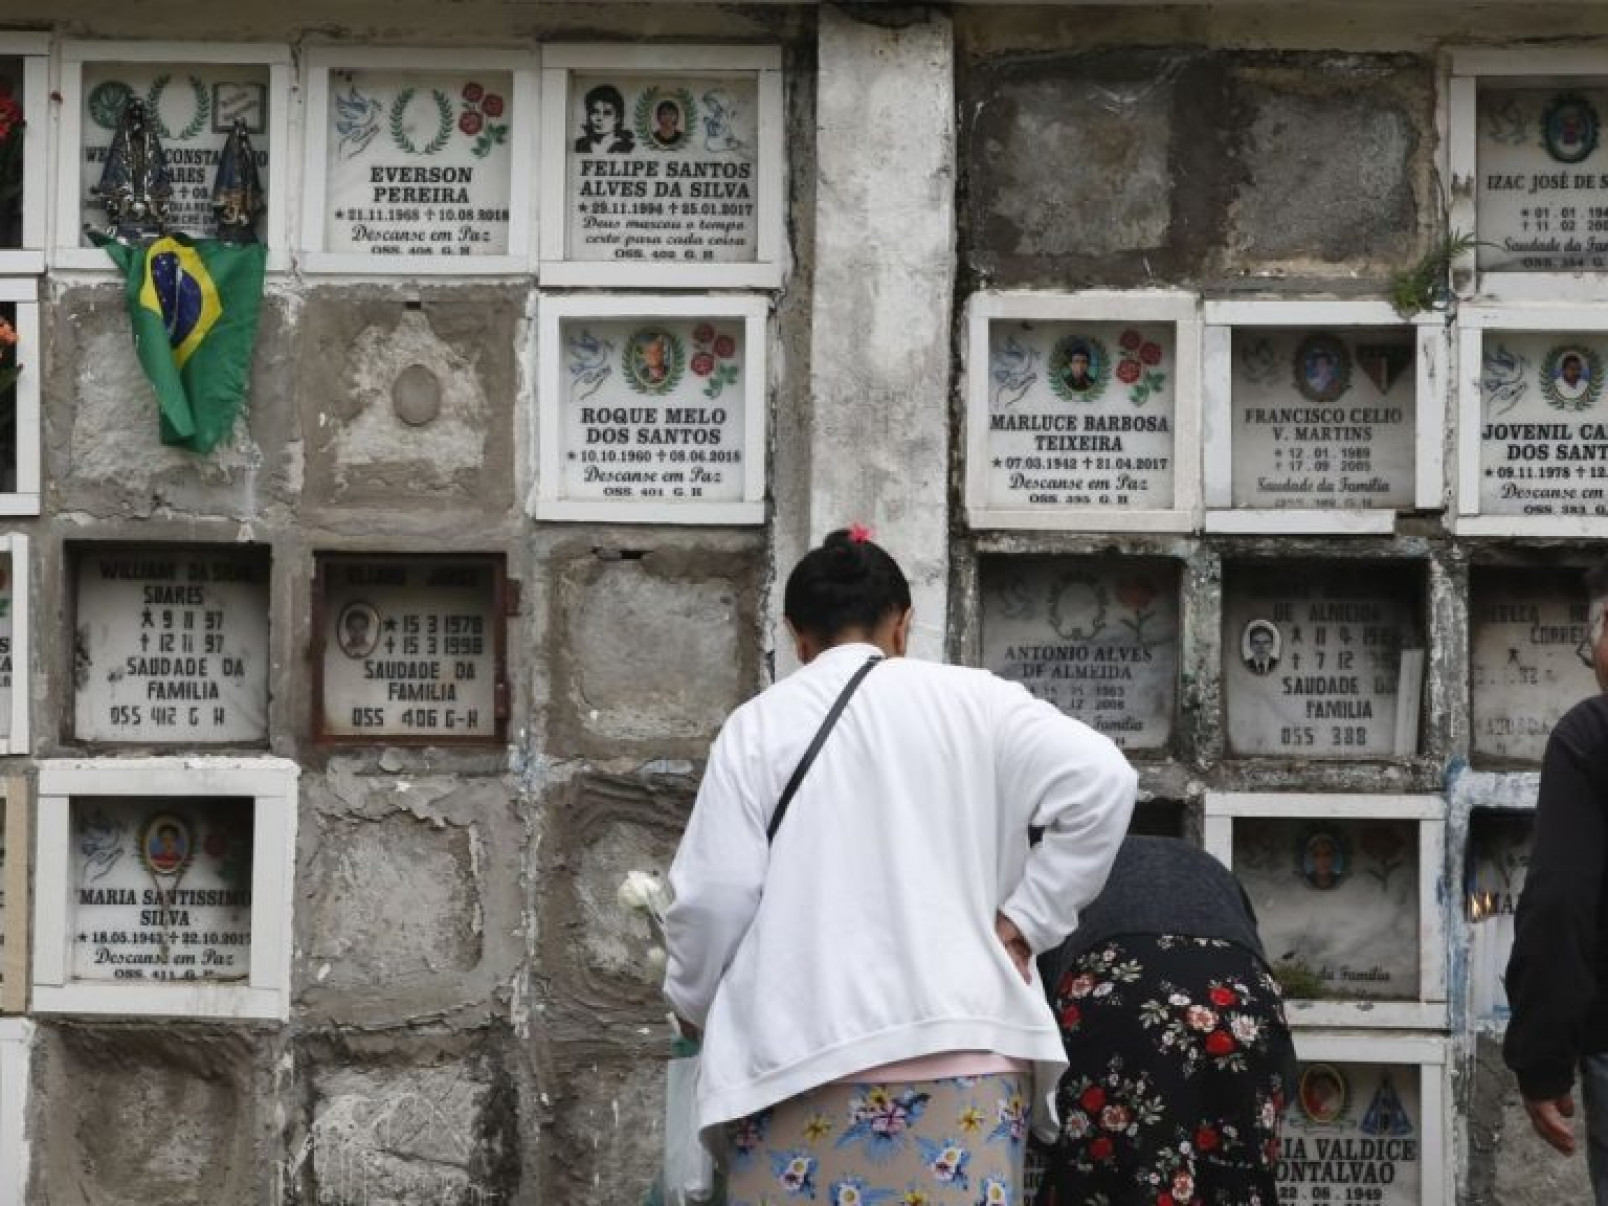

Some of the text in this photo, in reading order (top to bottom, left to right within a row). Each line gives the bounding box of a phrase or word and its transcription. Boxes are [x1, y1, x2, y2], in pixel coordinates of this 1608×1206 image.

[370, 167, 473, 183] EVERSON
[580, 160, 751, 178] FELIPE SANTOS
[580, 181, 750, 198] ALVES DA SILVA
[1488, 175, 1525, 190] IZAC
[1574, 175, 1595, 189] DE
[373, 186, 470, 203] PEREIRA
[581, 407, 727, 424] ROQUE MELO
[990, 414, 1168, 432] MARLUCE BARBOSA
[1245, 408, 1403, 424] FRANCISCO CELIO
[586, 428, 721, 444] DOS SANTOS
[1295, 426, 1372, 441] MARTINS
[1482, 423, 1572, 440] JOVENIL
[1034, 435, 1122, 451] TEIXEIRA
[1507, 444, 1549, 461] DOS
[143, 585, 204, 605] SOARES
[1004, 645, 1152, 663] ANTONIO ALVES
[127, 657, 245, 677] SAUDADE DA
[364, 660, 475, 680] SAUDADE DA
[1023, 664, 1131, 679] DE ALMEIDA
[148, 680, 219, 700] FAMILIA
[388, 682, 456, 701] FAMILIA
[1282, 676, 1359, 695] SAUDADE
[213, 707, 225, 726] H
[402, 707, 438, 727] 406
[1306, 700, 1372, 719] FAMILIA
[78, 888, 136, 905] MARIA
[1316, 1138, 1417, 1161] VALDICE
